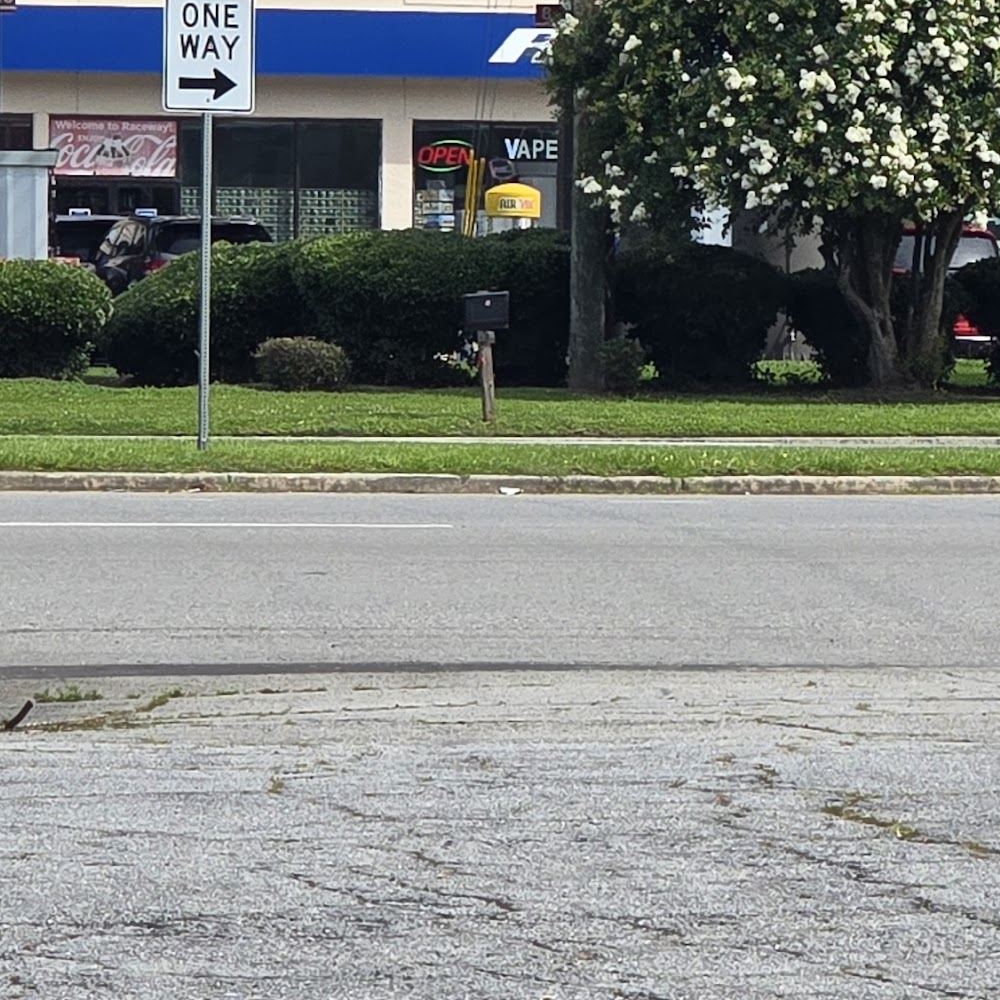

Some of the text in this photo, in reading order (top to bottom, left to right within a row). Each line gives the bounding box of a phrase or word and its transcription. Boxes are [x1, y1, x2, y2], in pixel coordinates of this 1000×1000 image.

[182, 2, 239, 29] ONE
[180, 33, 241, 61] WAY
[55, 120, 174, 134] Welcome to Raceway!
[417, 146, 472, 166] OPEN
[504, 137, 559, 160] VAPE
[499, 198, 517, 210] AIR
